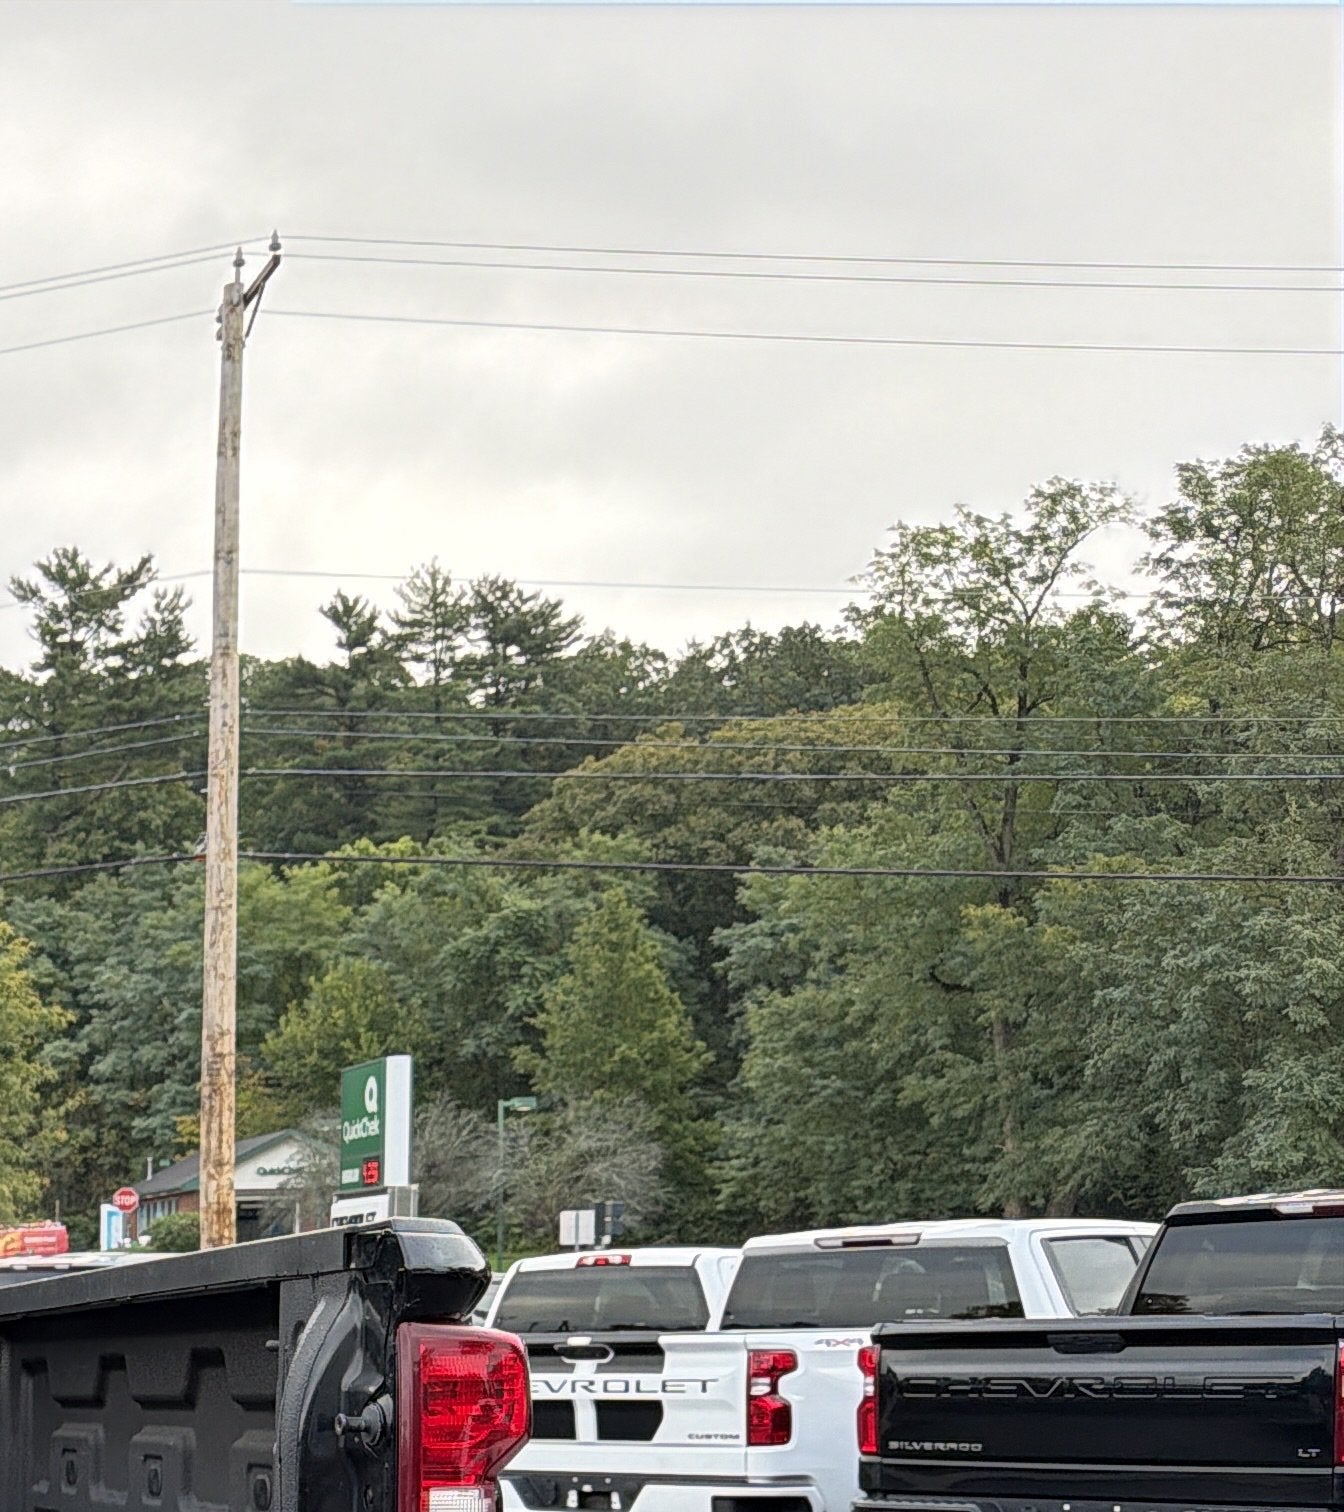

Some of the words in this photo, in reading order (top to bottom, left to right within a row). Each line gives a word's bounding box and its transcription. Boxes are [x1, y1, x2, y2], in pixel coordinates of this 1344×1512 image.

[115, 1195, 136, 1206] STOP
[531, 1378, 719, 1394] EVROLET
[903, 1376, 1295, 1399] CHEVROLET
[887, 1440, 984, 1453] SILVERADO
